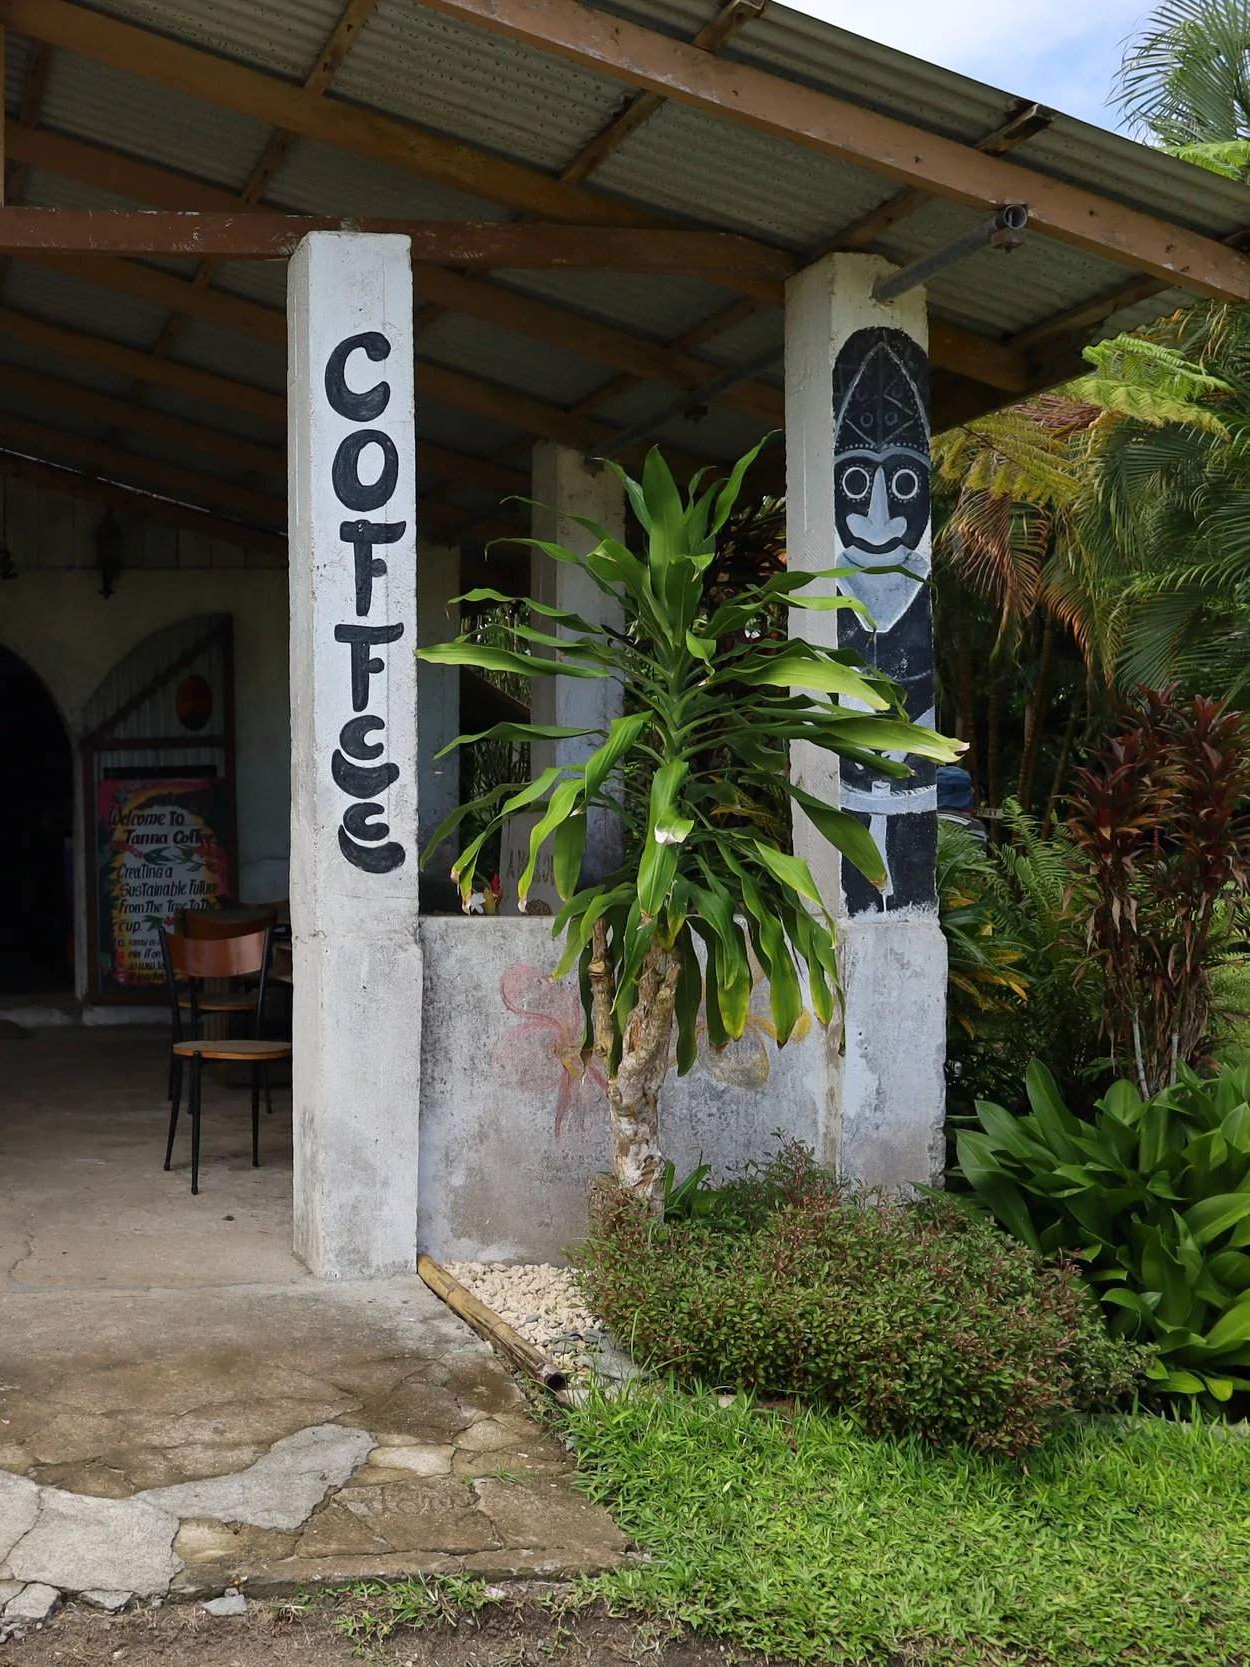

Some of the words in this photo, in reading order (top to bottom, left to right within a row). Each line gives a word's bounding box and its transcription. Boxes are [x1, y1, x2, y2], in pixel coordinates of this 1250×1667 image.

[109, 806, 166, 827] Welcome
[125, 829, 168, 845] Tanna
[165, 867, 174, 879] a
